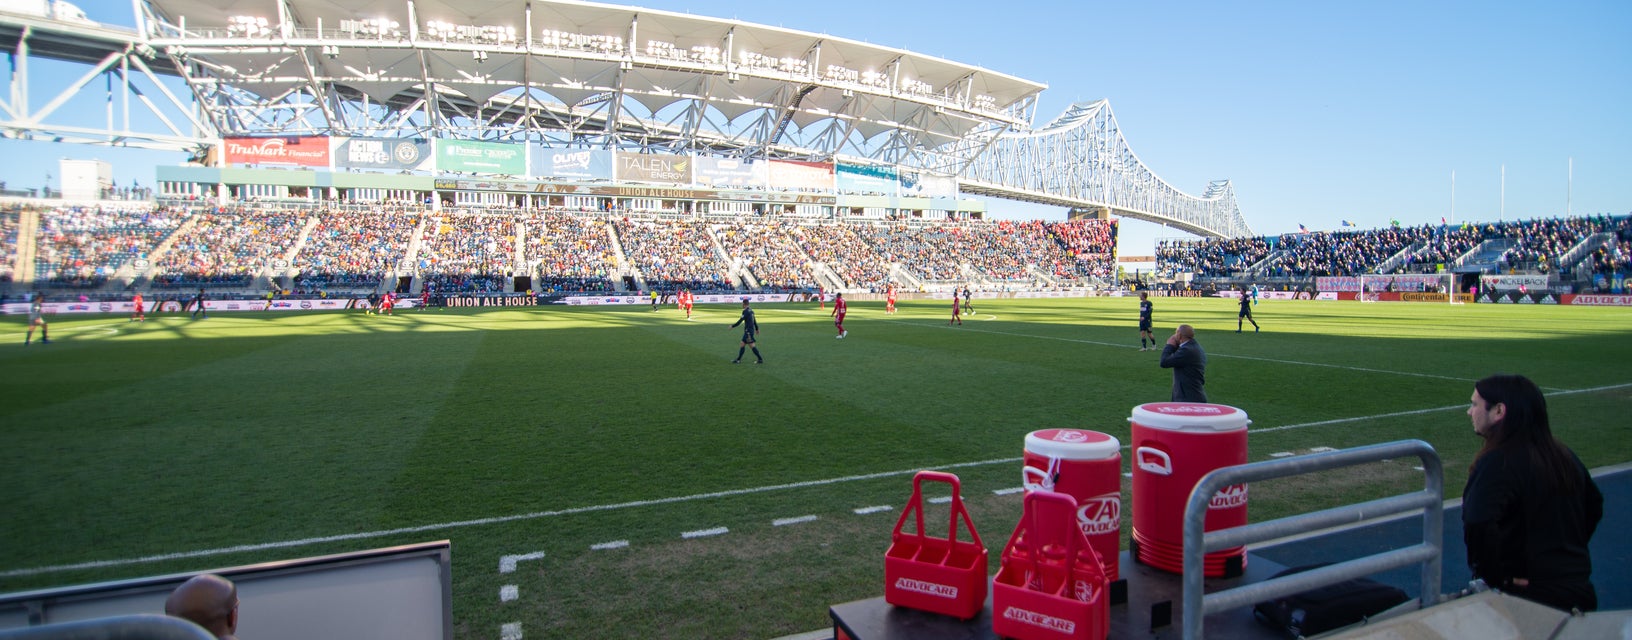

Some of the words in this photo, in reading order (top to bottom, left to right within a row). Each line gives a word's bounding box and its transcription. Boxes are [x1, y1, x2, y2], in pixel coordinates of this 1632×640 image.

[228, 143, 286, 157] TruMark
[349, 141, 383, 152] ACTION
[349, 152, 375, 162] NEWS
[621, 156, 671, 172] TALEN
[650, 171, 685, 180] ENERGY
[619, 187, 646, 196] UNION
[649, 188, 665, 197] ALE
[667, 189, 695, 198] HOUSE
[1500, 278, 1546, 286] NICKELBACK
[447, 297, 480, 307] UNION
[483, 297, 502, 307] ALE
[505, 296, 538, 306] HOUSE
[1402, 292, 1445, 301] Continental
[897, 578, 957, 598] ADVOCARE
[1005, 607, 1075, 634] ADVOCARE
